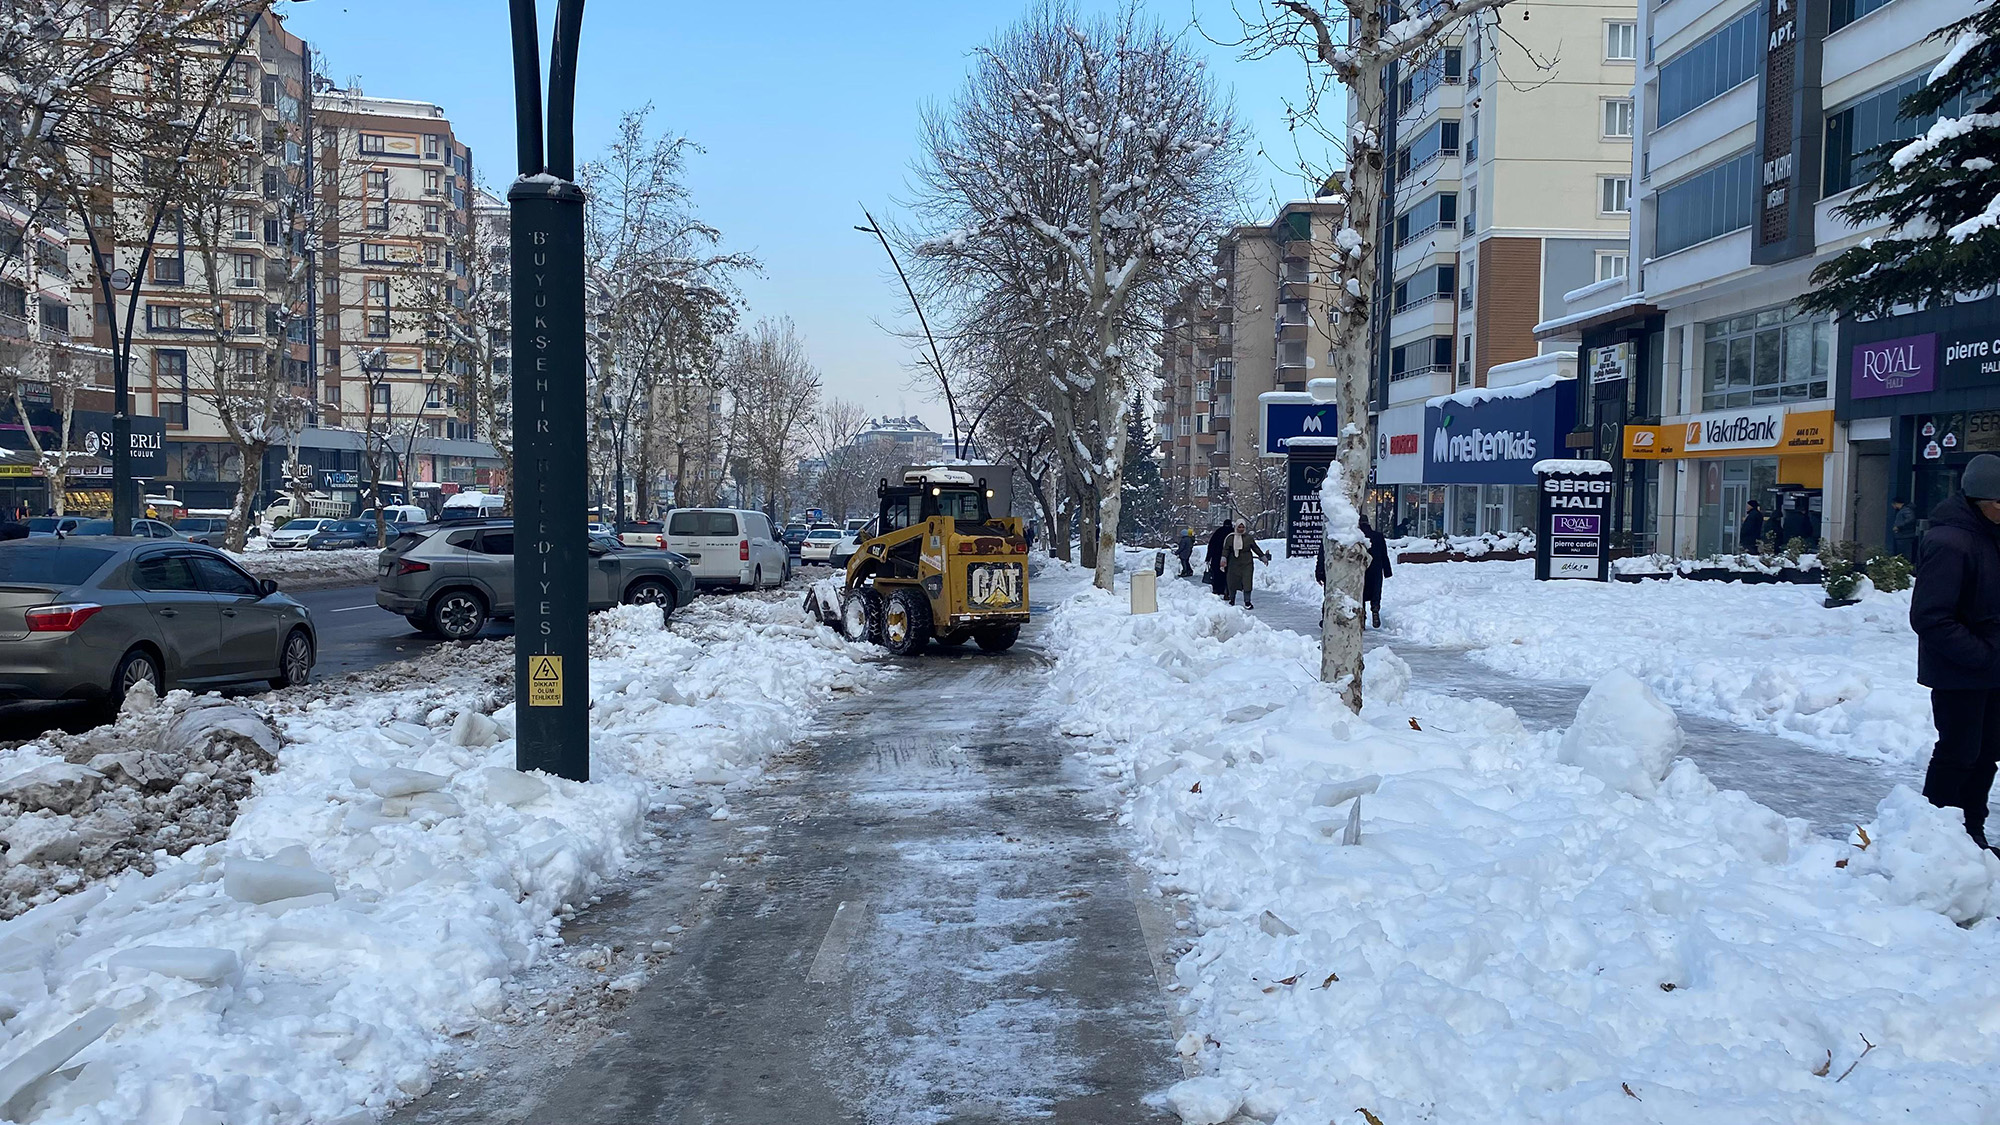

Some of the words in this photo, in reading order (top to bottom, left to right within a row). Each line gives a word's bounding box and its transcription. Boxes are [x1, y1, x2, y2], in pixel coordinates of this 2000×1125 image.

[1769, 21, 1796, 51] APT.
[1946, 341, 1989, 366] pierre
[1863, 345, 1921, 381] ROYAL
[101, 432, 161, 450] ŞERLİ
[1300, 502, 1324, 513] AL
[1551, 495, 1603, 509] HALI
[1561, 517, 1593, 529] ROYAL
[1576, 540, 1597, 548] cardin
[972, 568, 1020, 603] CAT
